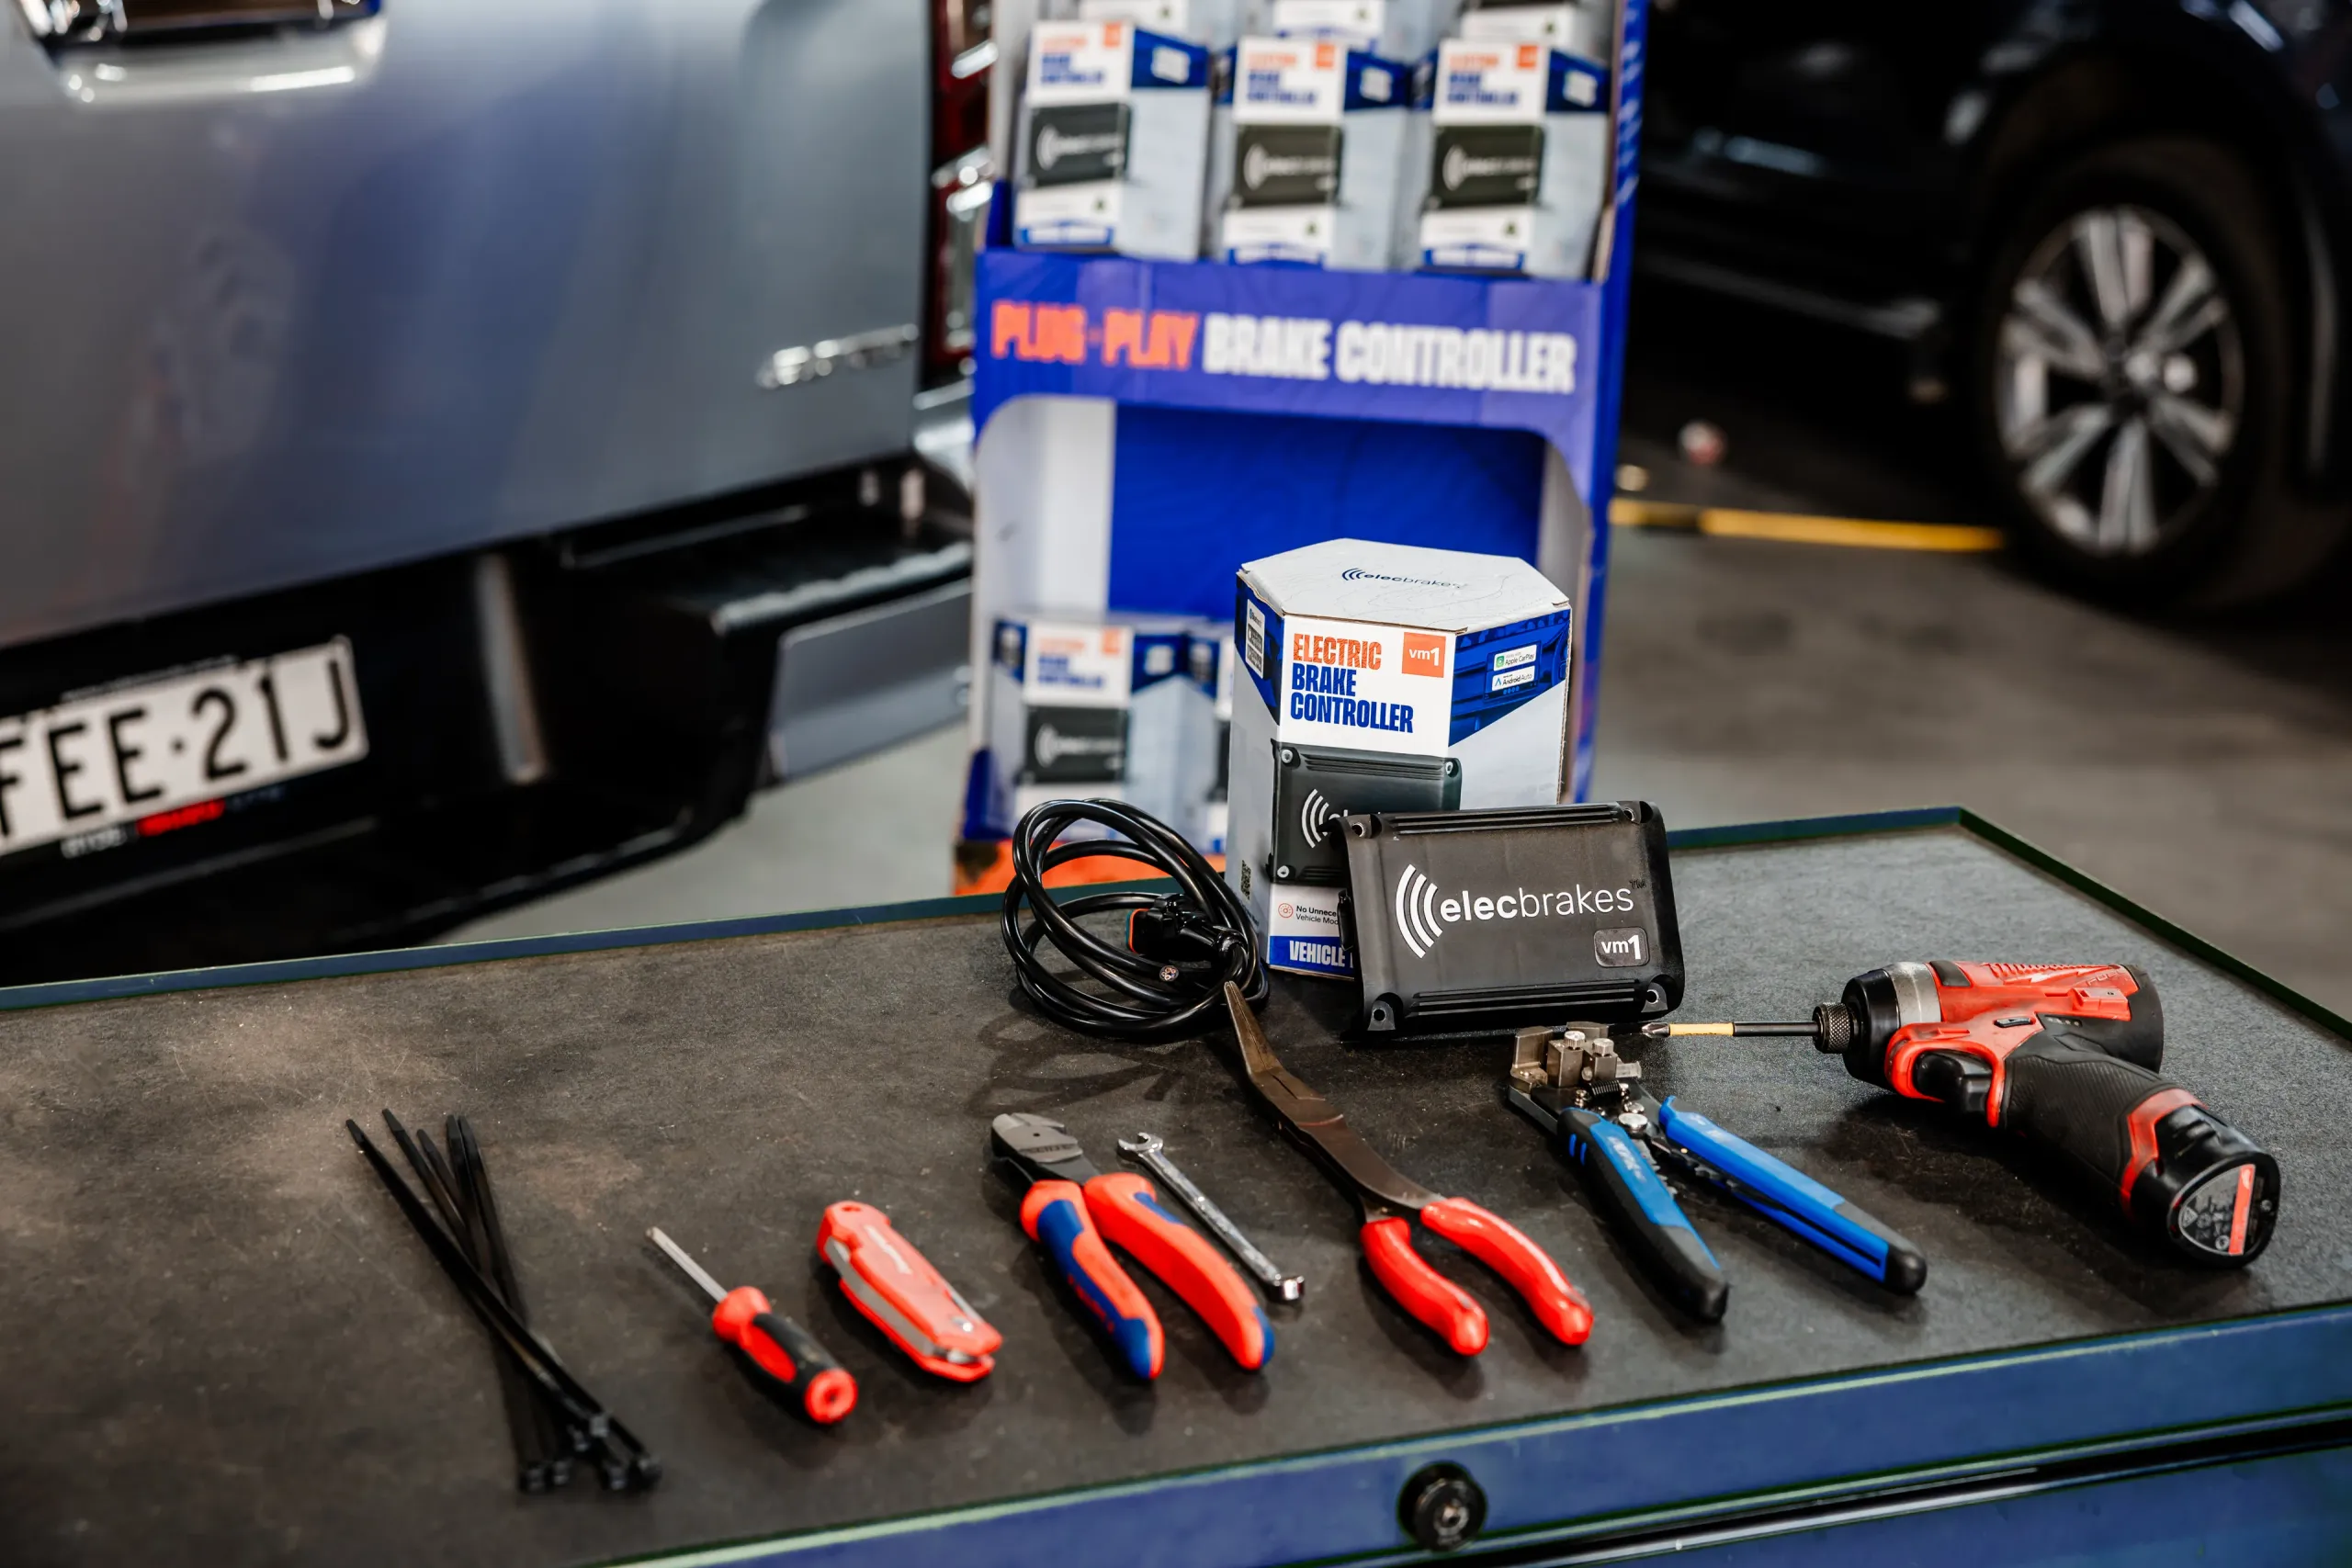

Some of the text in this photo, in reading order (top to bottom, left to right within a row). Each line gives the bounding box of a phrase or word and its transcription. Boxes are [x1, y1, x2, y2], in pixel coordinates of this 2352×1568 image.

[1204, 312, 1331, 380] BRAKE
[1335, 320, 1577, 393] CONTROLLER
[1293, 633, 1382, 670] ELECTRIC
[1408, 647, 1440, 666] vm1
[1505, 653, 1534, 666] Apple CarPlay
[1292, 662, 1357, 696] BRAKE
[1503, 676, 1521, 684] Android
[1290, 692, 1414, 733] CONTROLLER
[1296, 905, 1337, 917] No Unnece
[1440, 884, 1634, 922] elecbrakes
[1295, 913, 1321, 923] Vehicle
[1289, 940, 1345, 967] VEHICLE
[1600, 934, 1642, 960] vm1
